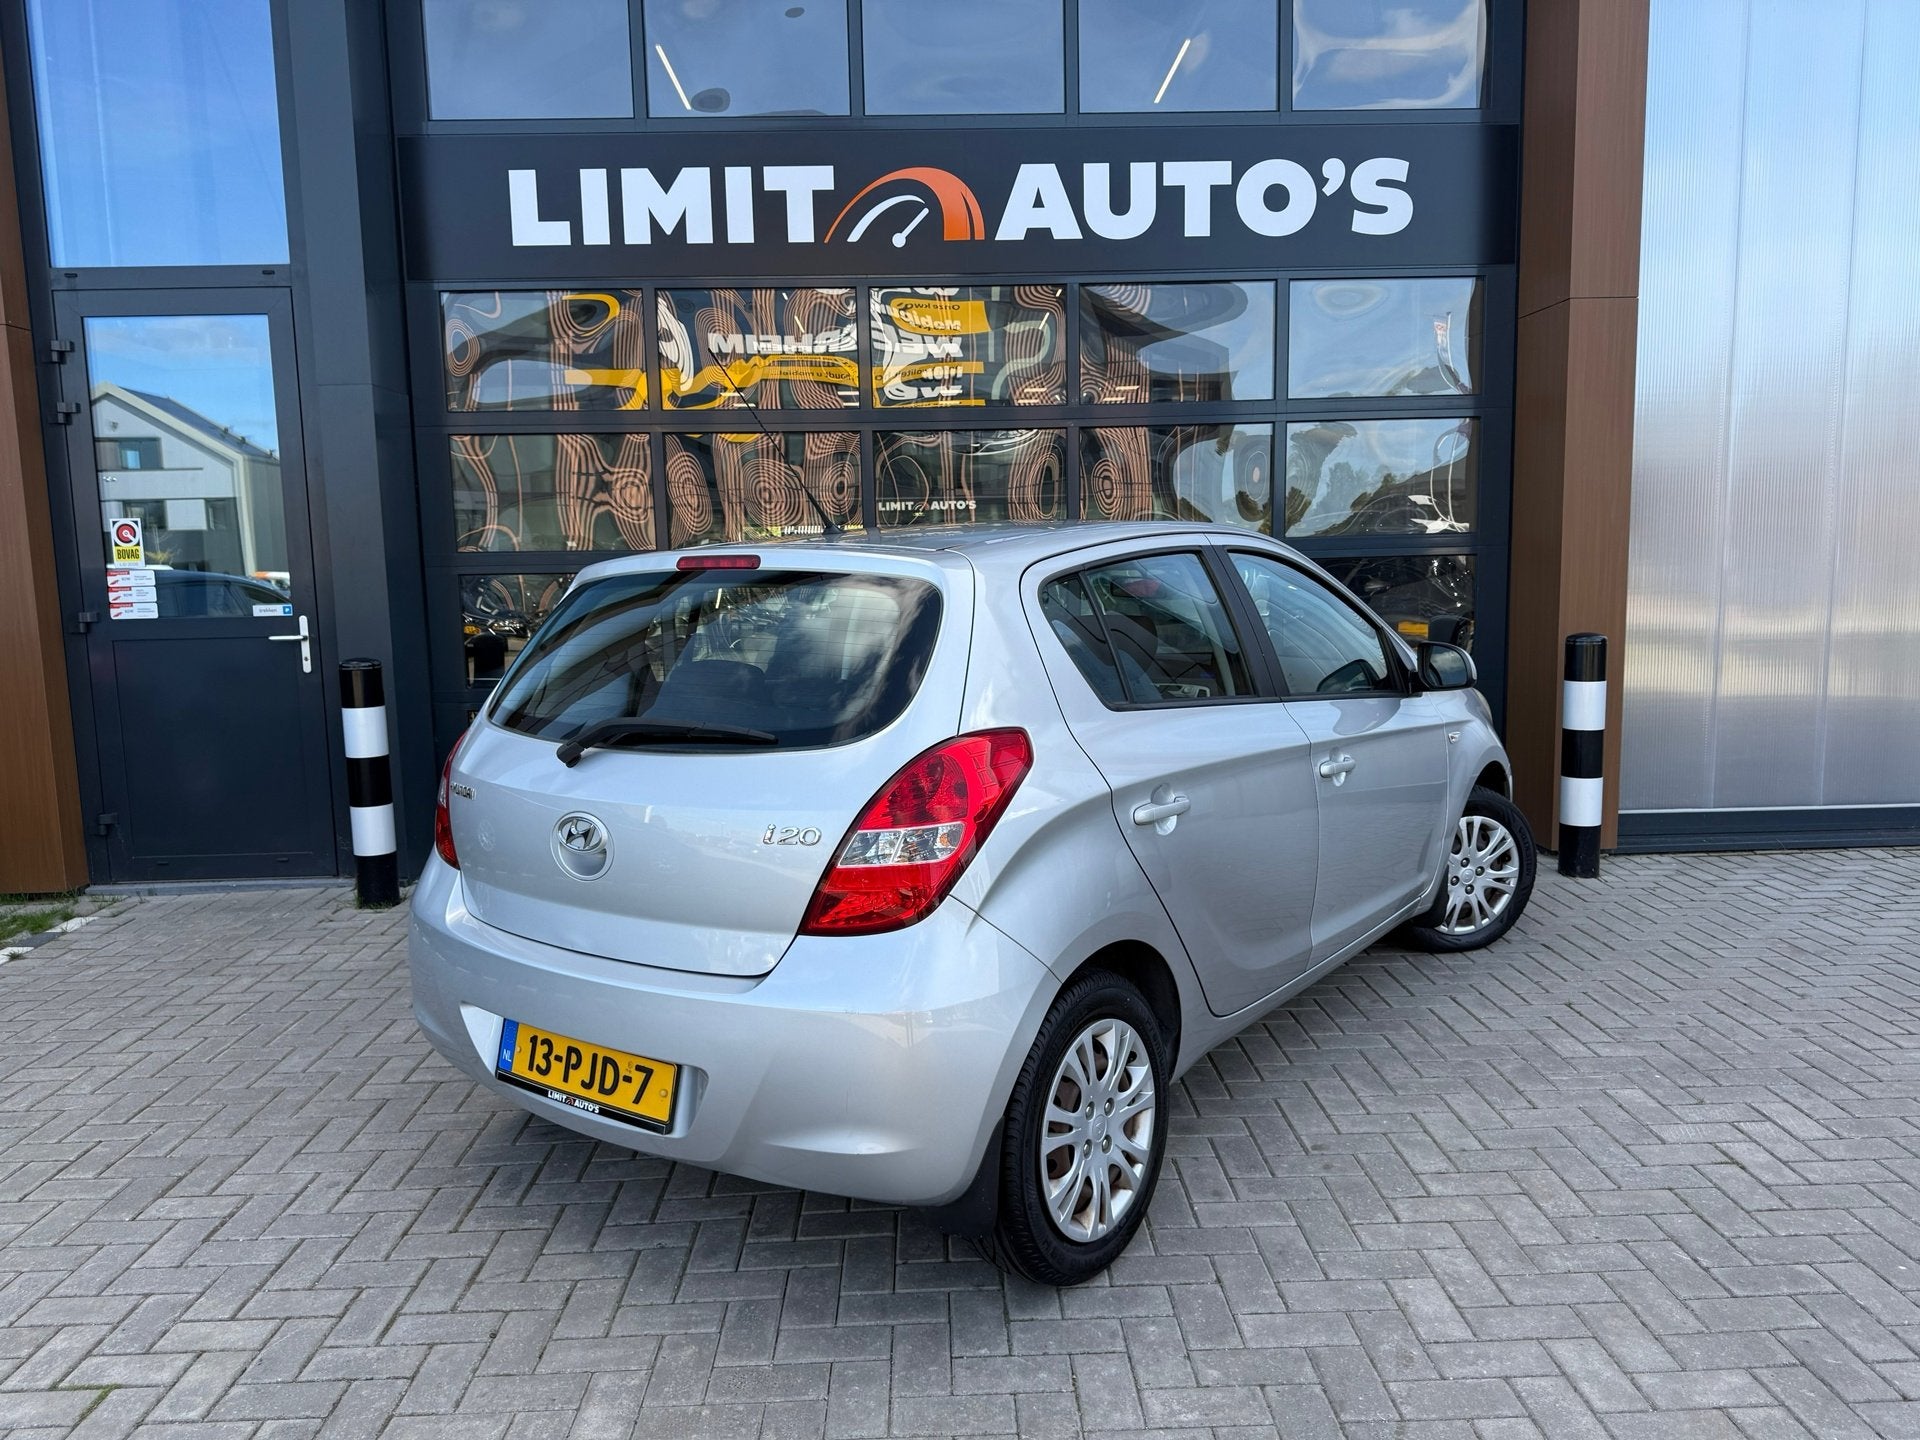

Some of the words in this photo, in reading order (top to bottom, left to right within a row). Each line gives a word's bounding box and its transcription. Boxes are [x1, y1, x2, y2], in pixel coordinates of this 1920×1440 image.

[508, 165, 835, 247] LIMIT
[995, 157, 1413, 242] AUTO'S
[878, 501, 914, 511] LIMIT
[930, 500, 977, 510] AUTO'S
[116, 548, 140, 560] BOVAG
[762, 823, 823, 846] i20
[502, 1049, 512, 1063] NL
[528, 1034, 654, 1105] 13-PJD-7
[547, 1090, 567, 1104] LIMIT
[574, 1100, 600, 1114] AUTO'S
